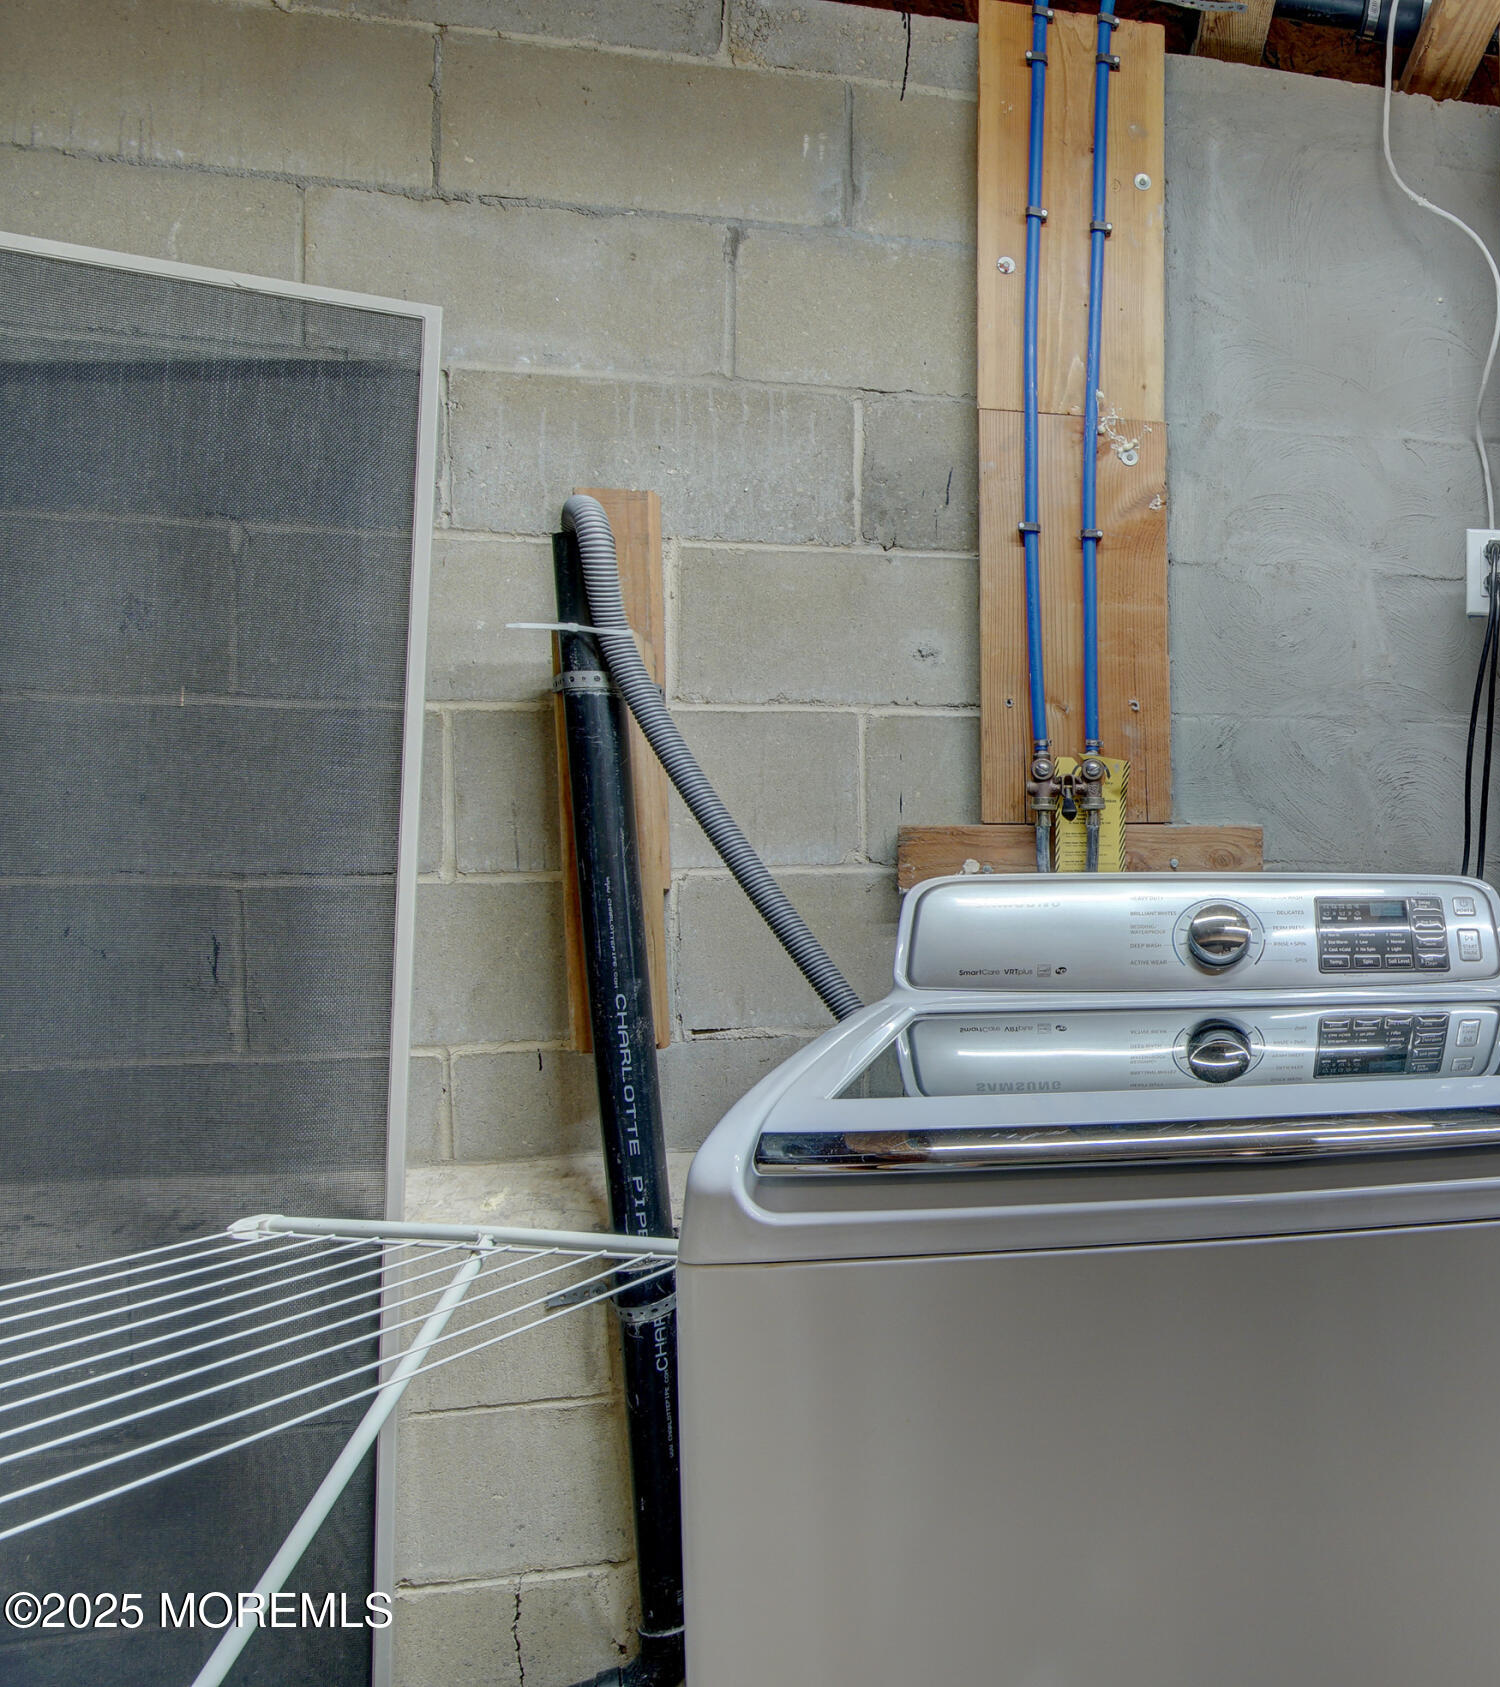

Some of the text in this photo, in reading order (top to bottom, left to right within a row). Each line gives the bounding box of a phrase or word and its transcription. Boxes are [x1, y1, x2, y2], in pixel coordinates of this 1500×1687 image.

[959, 968, 1033, 976] SmartCare VRTplus
[615, 993, 641, 1157] CHARLOTTE
